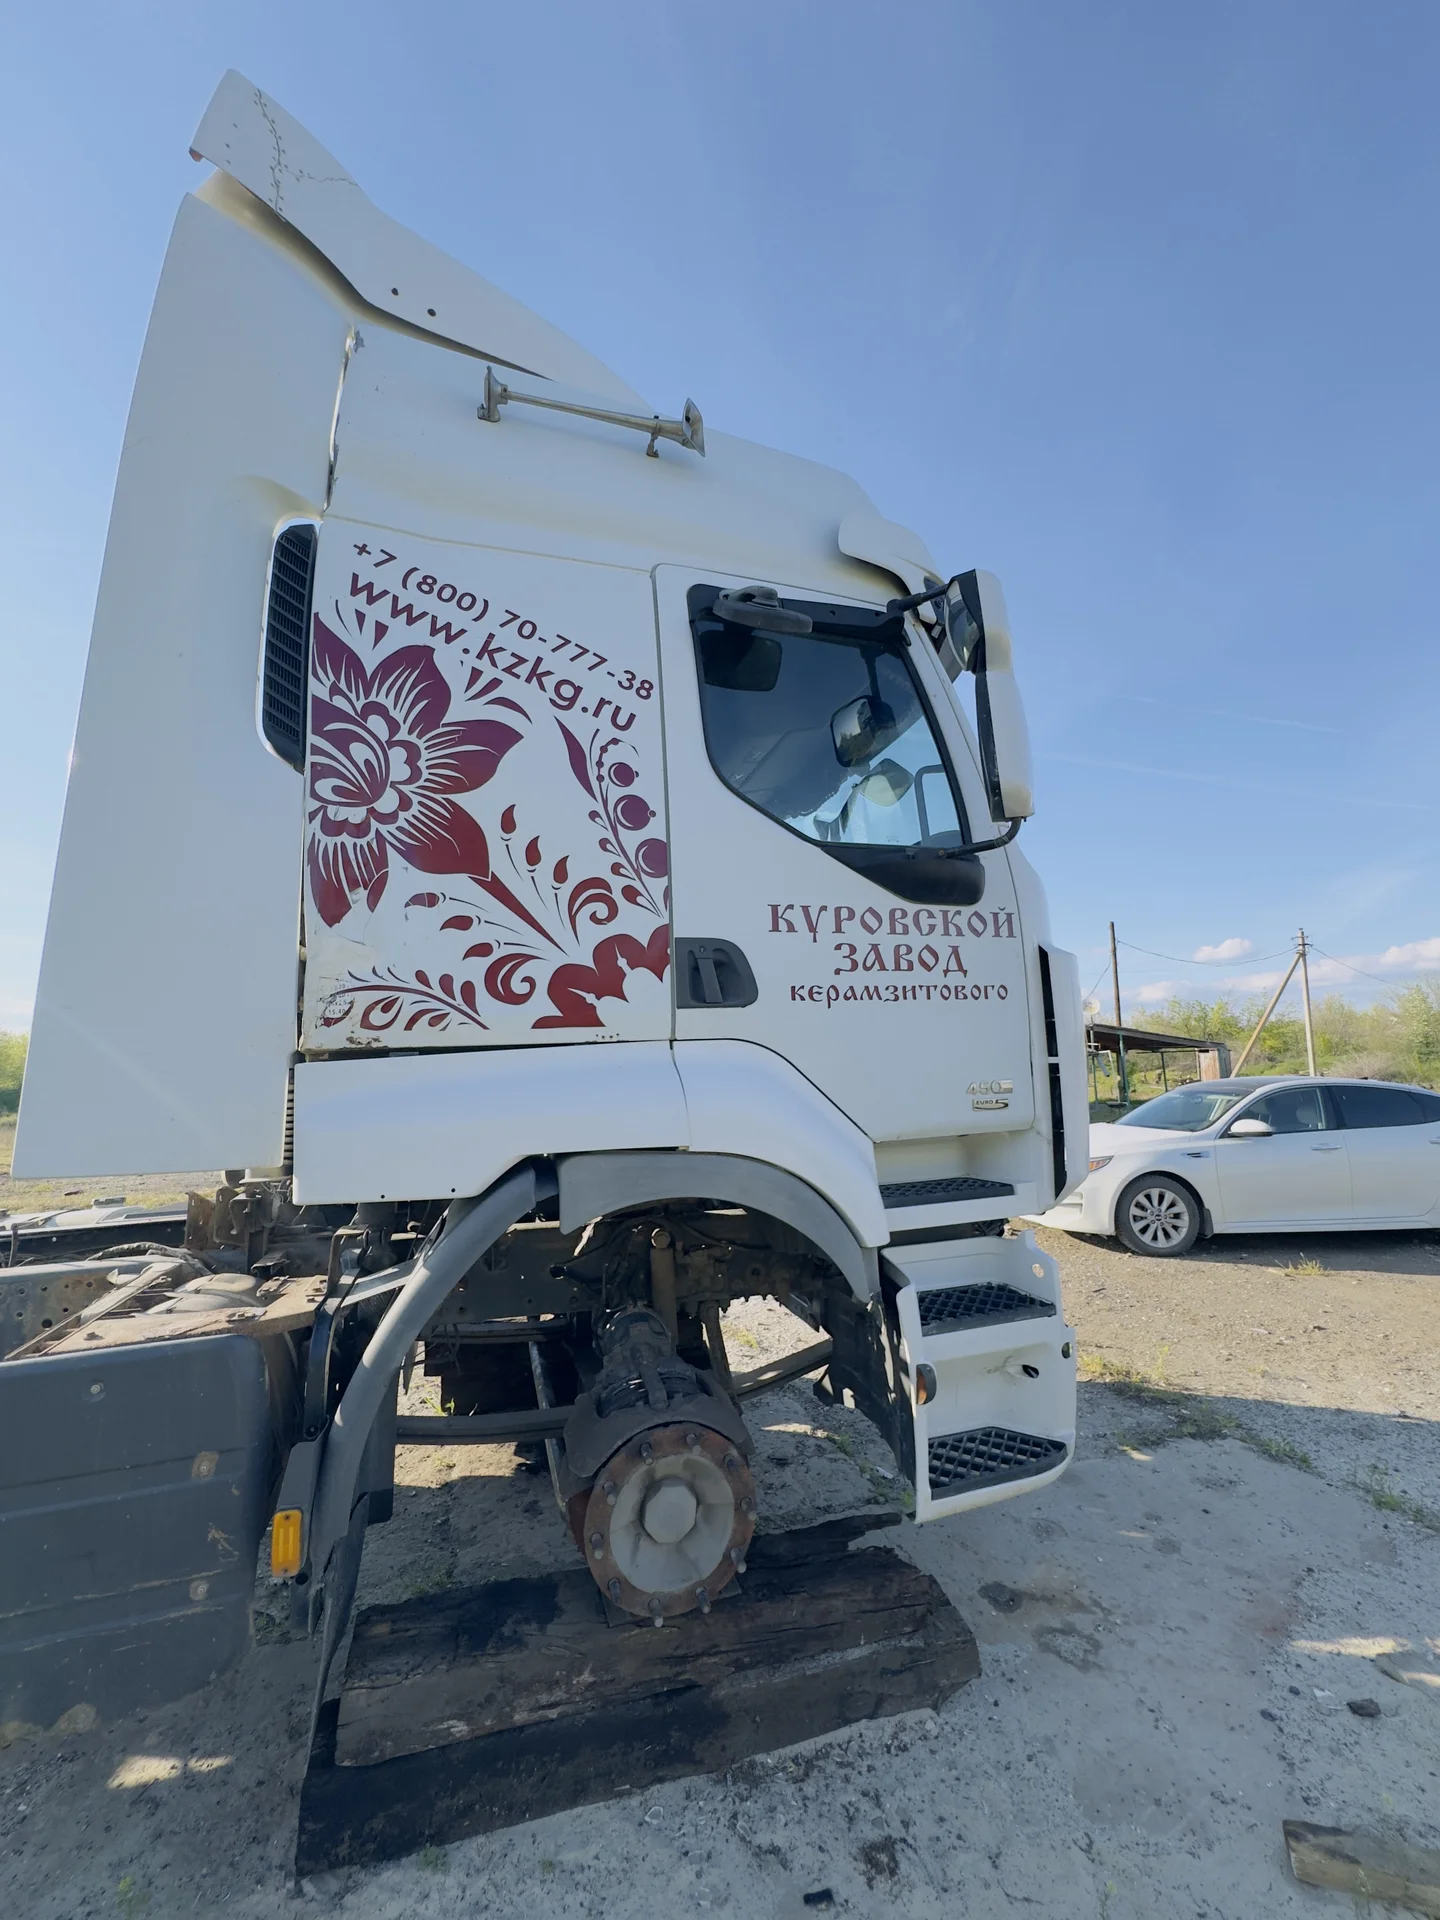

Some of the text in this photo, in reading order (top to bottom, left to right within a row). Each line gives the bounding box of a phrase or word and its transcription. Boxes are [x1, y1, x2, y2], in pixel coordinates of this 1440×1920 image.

[353, 543, 655, 701] +7 (800) 70-777-38
[350, 572, 637, 732] www.kzkg.ru
[767, 904, 1018, 943] КУРОВСКОЙ
[833, 942, 968, 978] ЗАВОД
[966, 1079, 1006, 1095] 450
